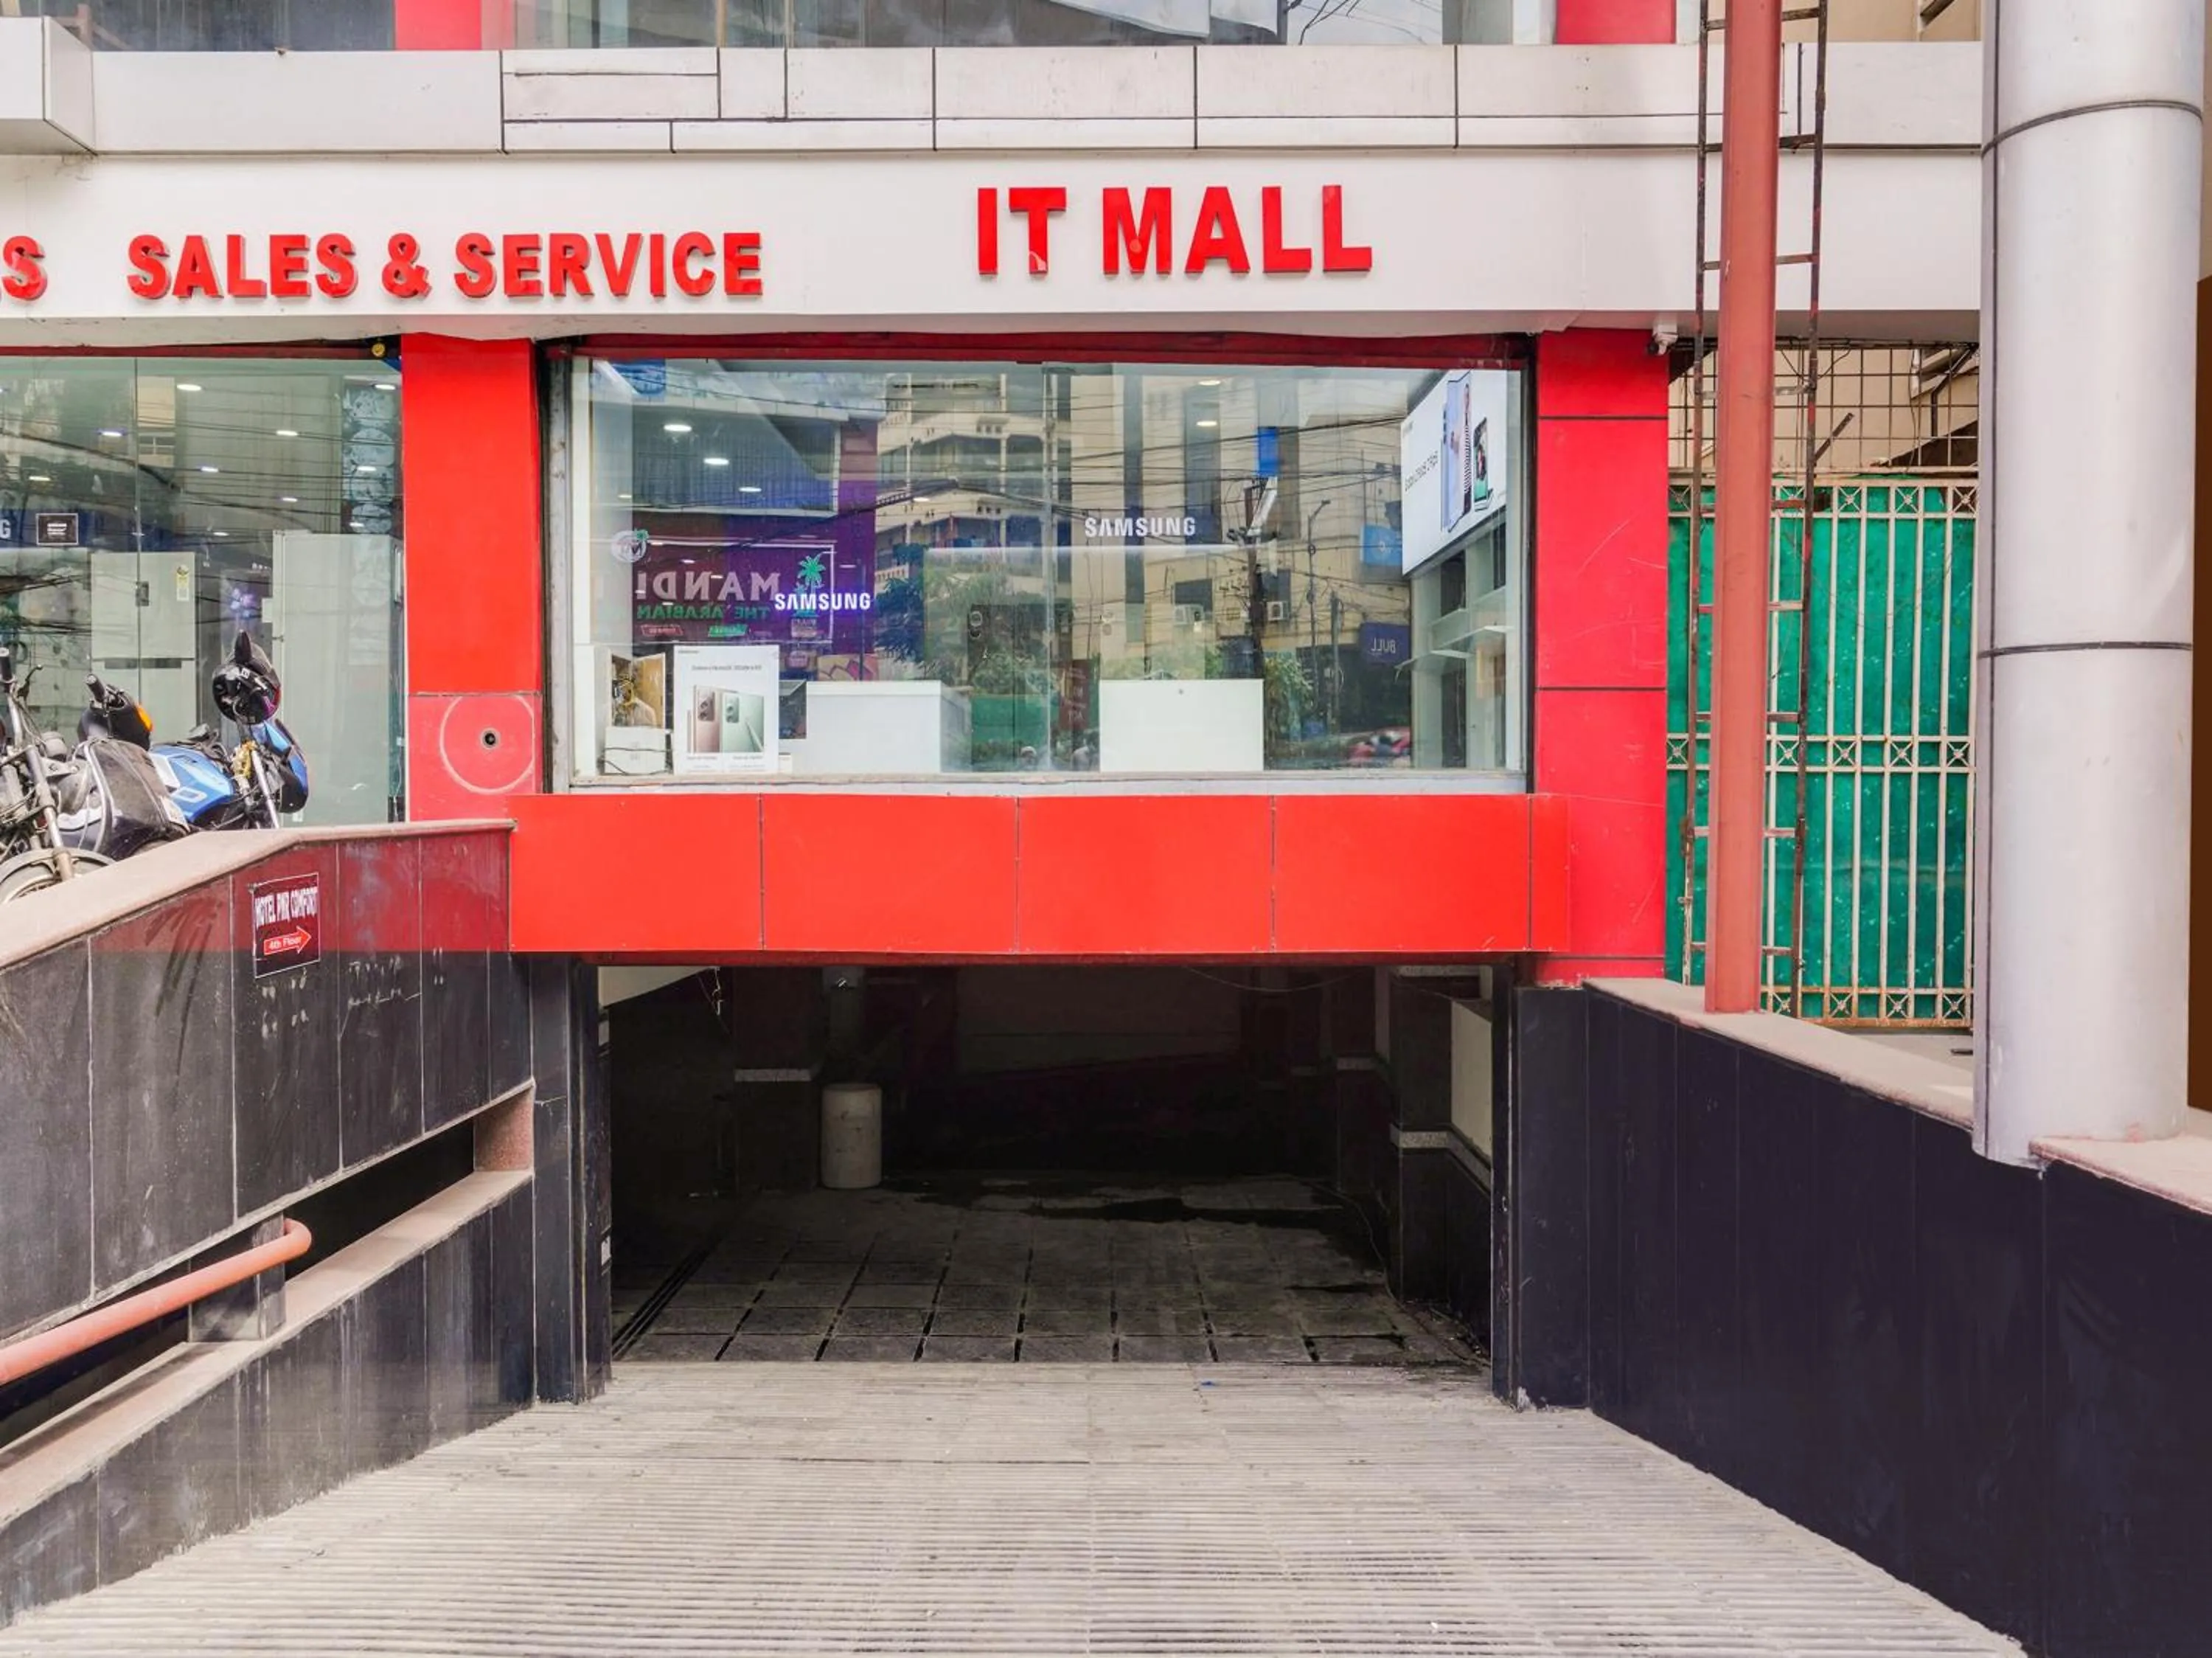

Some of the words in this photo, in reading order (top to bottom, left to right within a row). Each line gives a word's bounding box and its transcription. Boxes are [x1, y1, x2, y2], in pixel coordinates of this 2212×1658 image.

[977, 187, 1066, 276] IT
[1102, 184, 1373, 275] MALL
[127, 233, 358, 299] SALES
[381, 232, 432, 299] &
[453, 231, 764, 299] SERVICE
[1084, 517, 1197, 538] SAMSUNG
[774, 592, 872, 611] SAMSUNG
[268, 940, 282, 950] 4th
[282, 936, 302, 947] Floor
